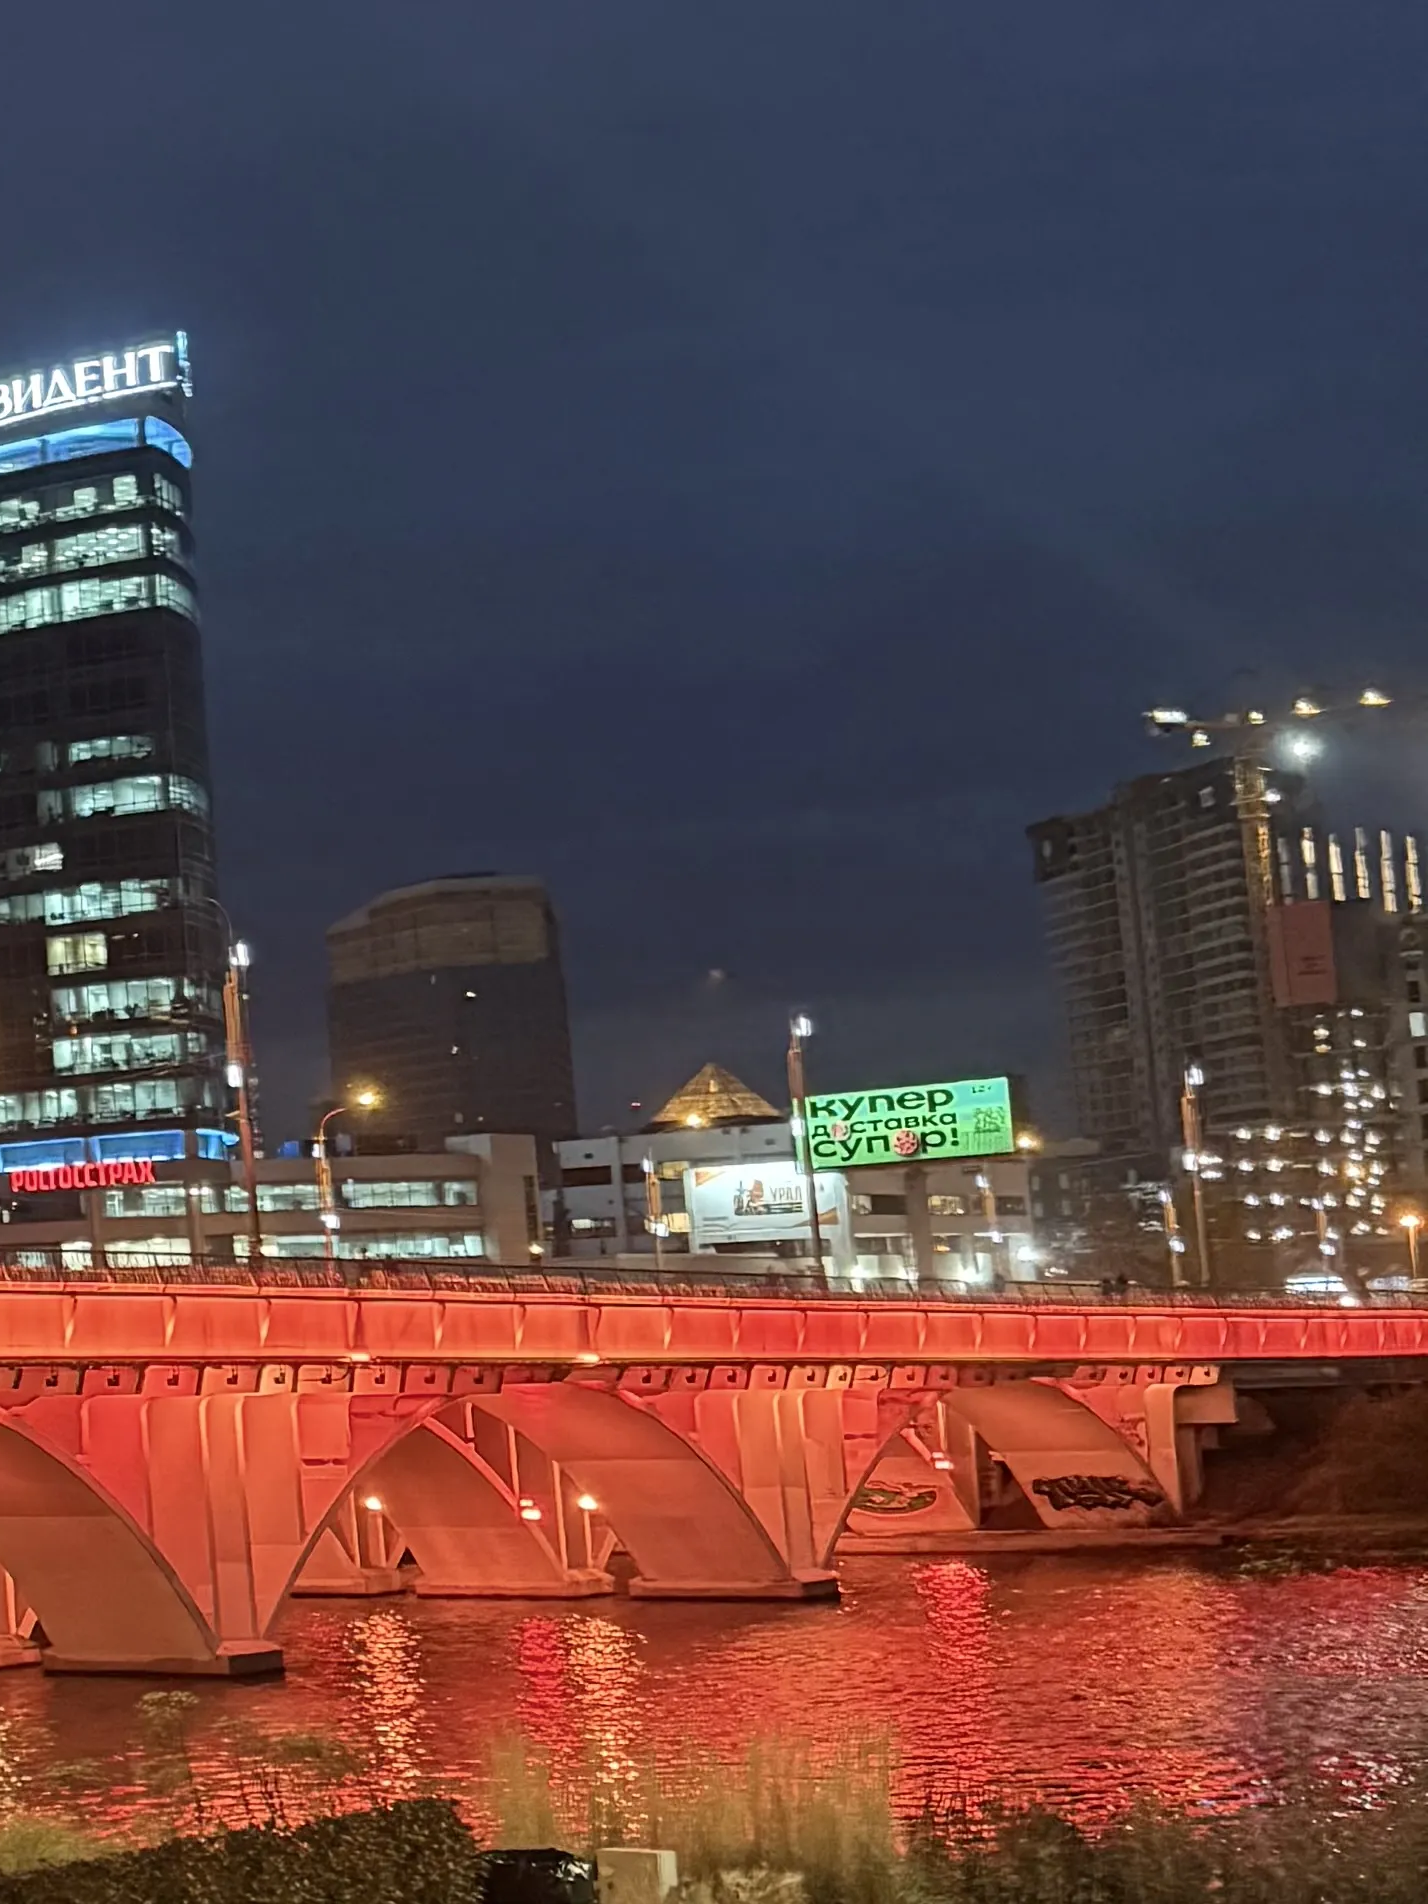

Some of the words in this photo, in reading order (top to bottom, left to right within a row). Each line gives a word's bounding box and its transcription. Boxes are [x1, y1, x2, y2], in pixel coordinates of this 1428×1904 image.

[809, 1088, 955, 1121] купер
[811, 1112, 958, 1140] дставка
[813, 1127, 960, 1162] супр!
